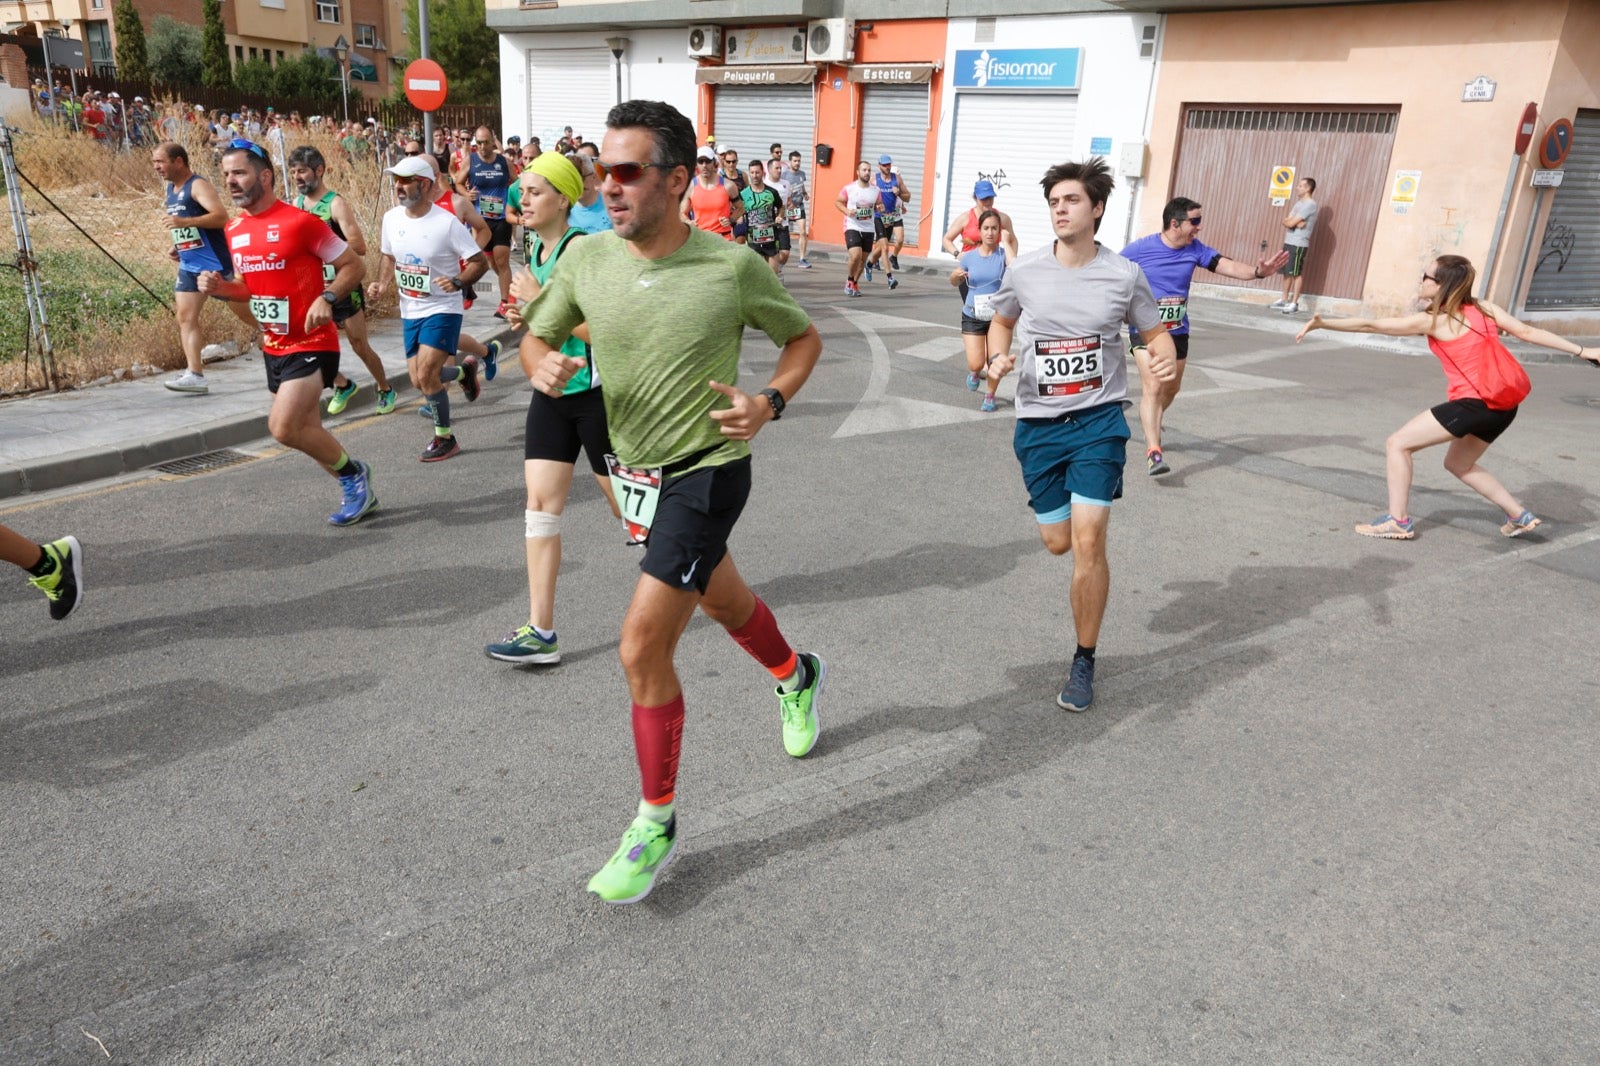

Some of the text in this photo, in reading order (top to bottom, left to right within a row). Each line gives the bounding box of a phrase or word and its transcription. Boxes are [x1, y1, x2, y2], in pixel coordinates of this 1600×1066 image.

[863, 69, 912, 80] Estetica
[988, 57, 1058, 80] fisiomar
[488, 203, 495, 212] 5
[174, 227, 194, 241] 742
[400, 273, 424, 290] 909
[253, 302, 280, 320] 593
[1159, 307, 1181, 320] 781
[1044, 353, 1098, 377] 3025
[622, 484, 647, 517] 77
